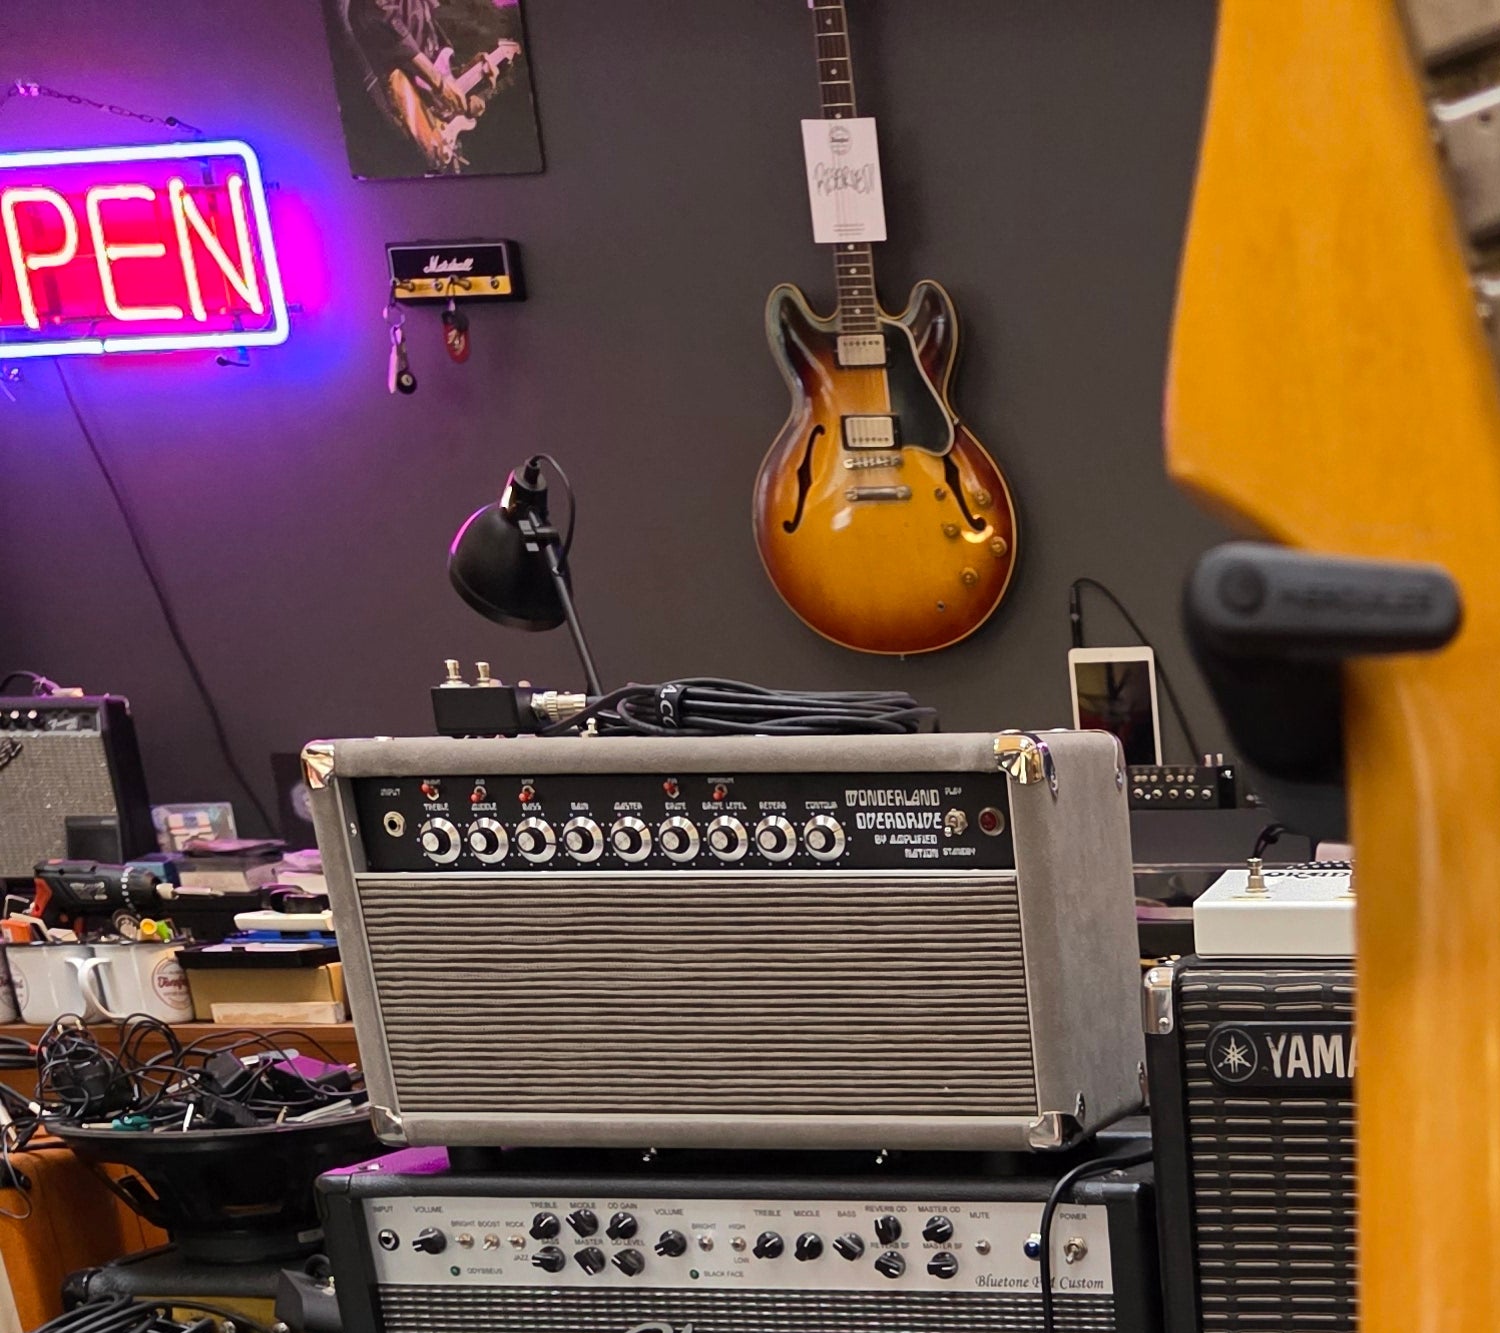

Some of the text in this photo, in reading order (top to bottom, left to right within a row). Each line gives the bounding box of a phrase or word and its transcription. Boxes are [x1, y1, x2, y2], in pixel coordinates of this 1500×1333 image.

[2, 174, 265, 330] PEN
[845, 789, 940, 807] WONDERLAND
[856, 811, 942, 830] OVERDRIVE
[889, 834, 938, 845] AMPLIFIED
[530, 1201, 557, 1209] TREBLE
[620, 1202, 638, 1210] GAIN
[654, 1208, 684, 1216] VOLUME
[753, 1209, 781, 1217] TREBLE
[837, 1210, 857, 1218] BASS
[975, 1273, 1029, 1288] Bluetone
[1059, 1276, 1104, 1290] Custom
